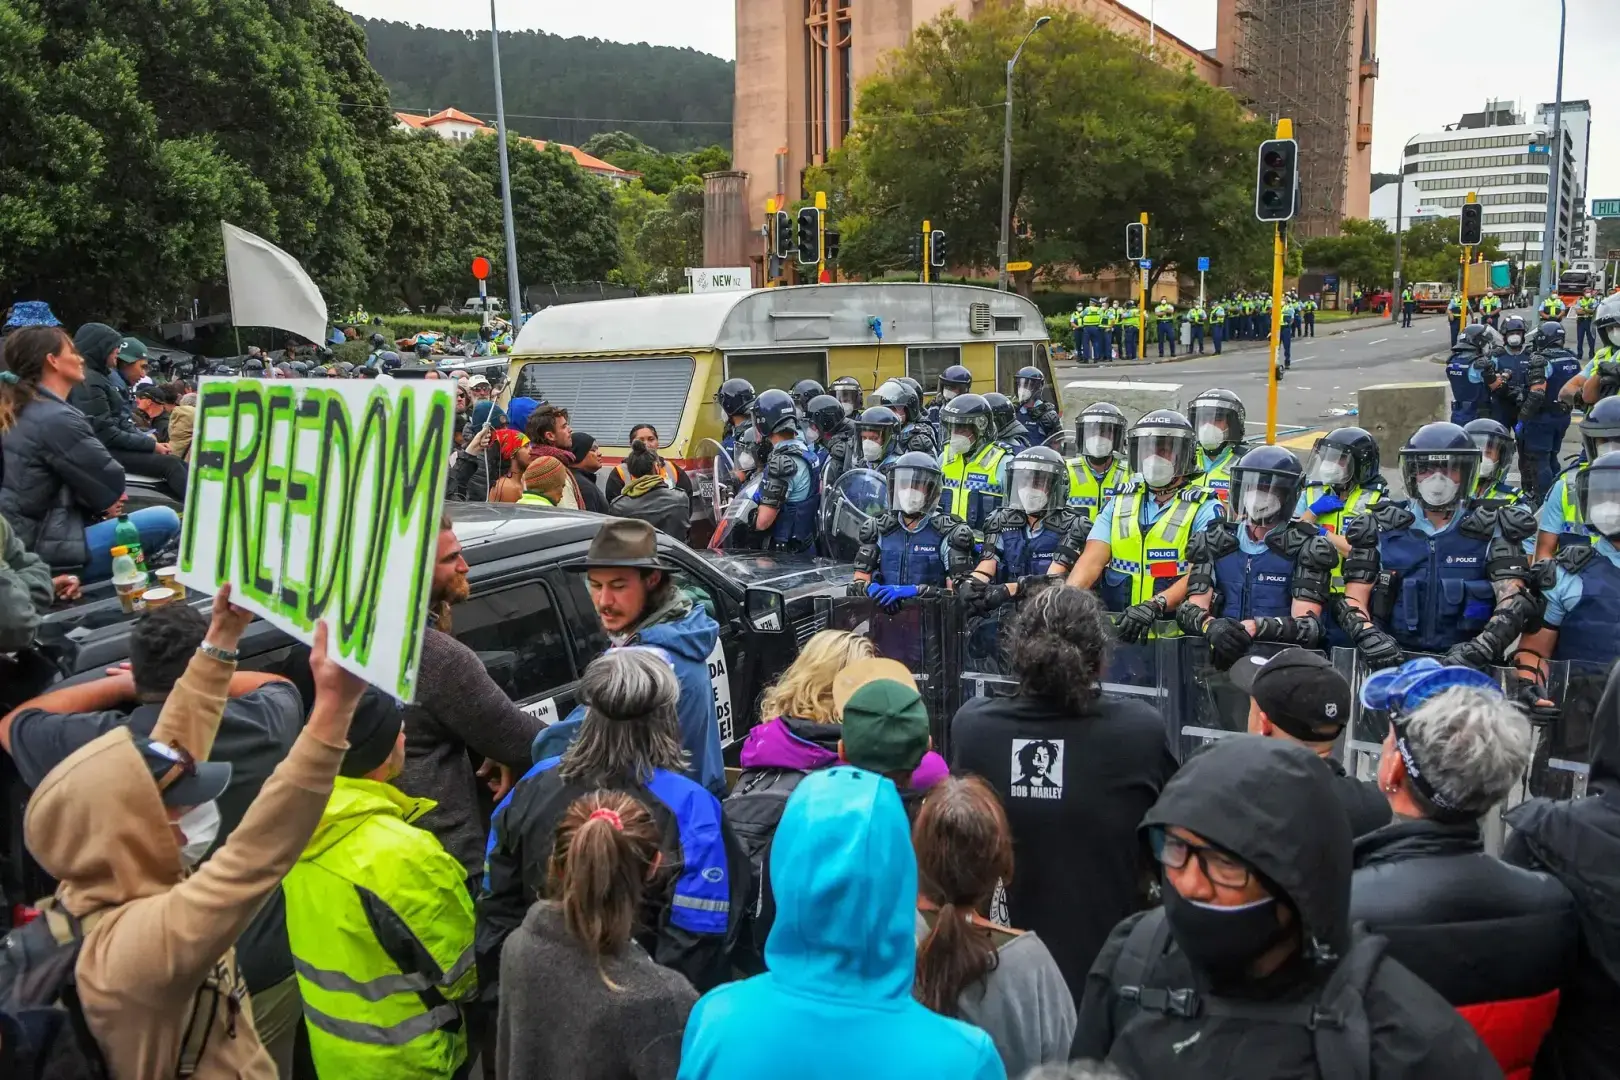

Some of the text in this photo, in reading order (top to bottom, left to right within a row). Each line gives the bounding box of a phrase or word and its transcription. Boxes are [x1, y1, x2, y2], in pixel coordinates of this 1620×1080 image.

[1598, 202, 1620, 214] HIL
[712, 275, 732, 287] NEW
[1138, 416, 1171, 425] POLICE
[181, 380, 451, 699] FREEDOM
[1455, 556, 1478, 564] POLICE
[1010, 785, 1063, 800] BOB MARLEY
